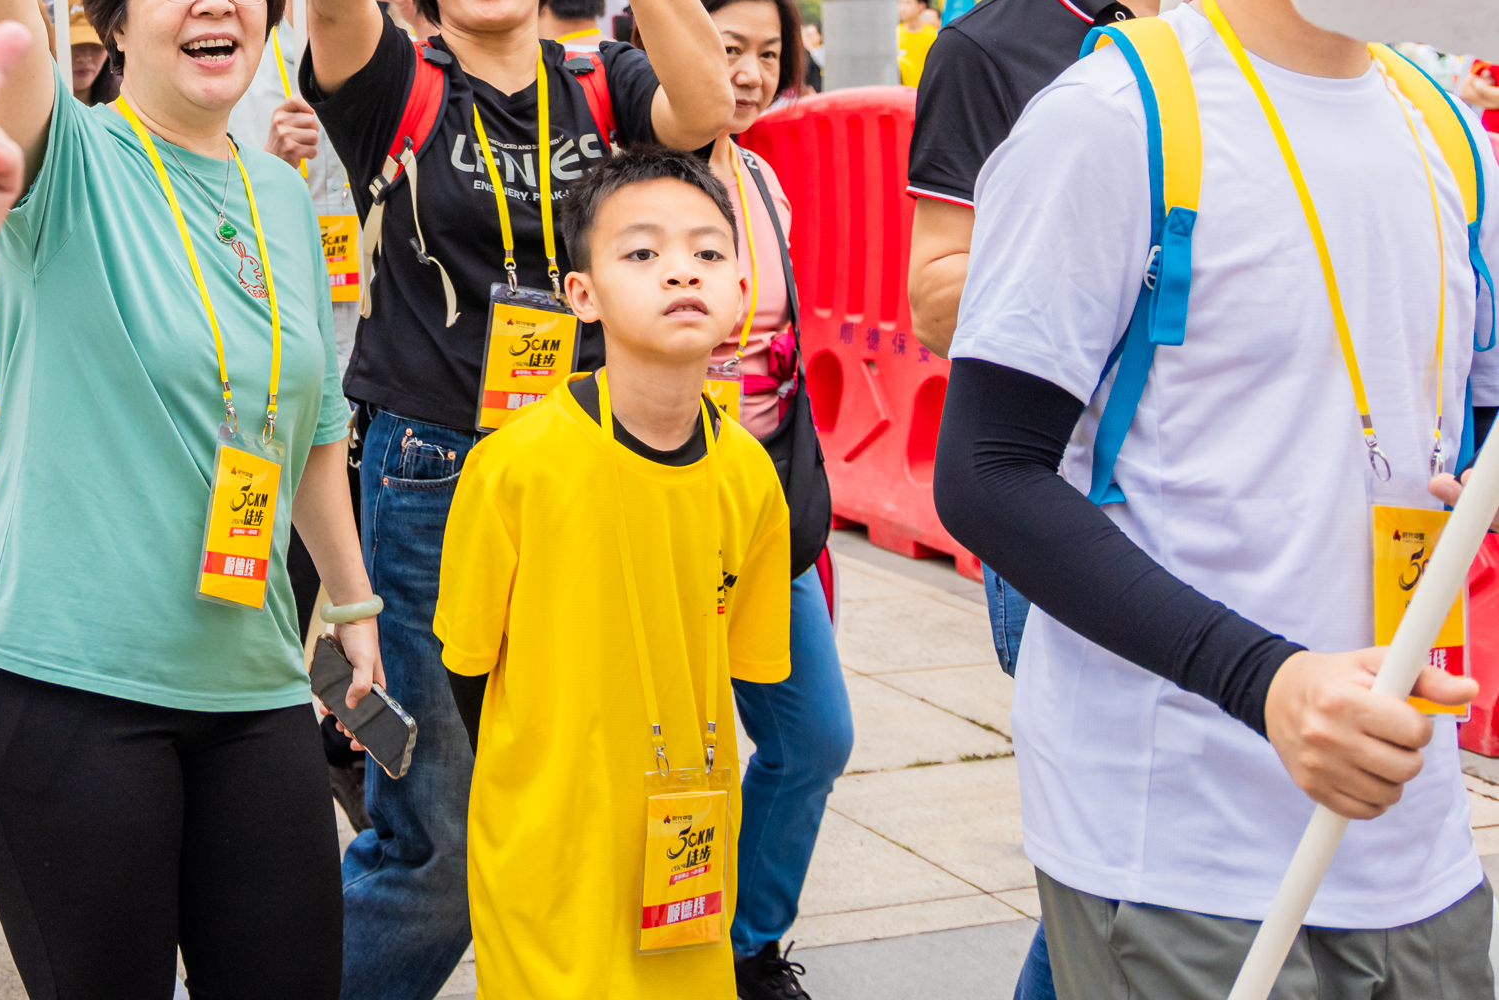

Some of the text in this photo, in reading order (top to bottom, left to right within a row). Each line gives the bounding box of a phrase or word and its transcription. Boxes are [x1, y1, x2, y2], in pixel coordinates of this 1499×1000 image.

[529, 353, 556, 367] 徒步
[244, 508, 264, 526] 徒步
[223, 556, 256, 577] 顺德线
[686, 845, 711, 868] 徒步
[666, 895, 706, 924] 顺德线
